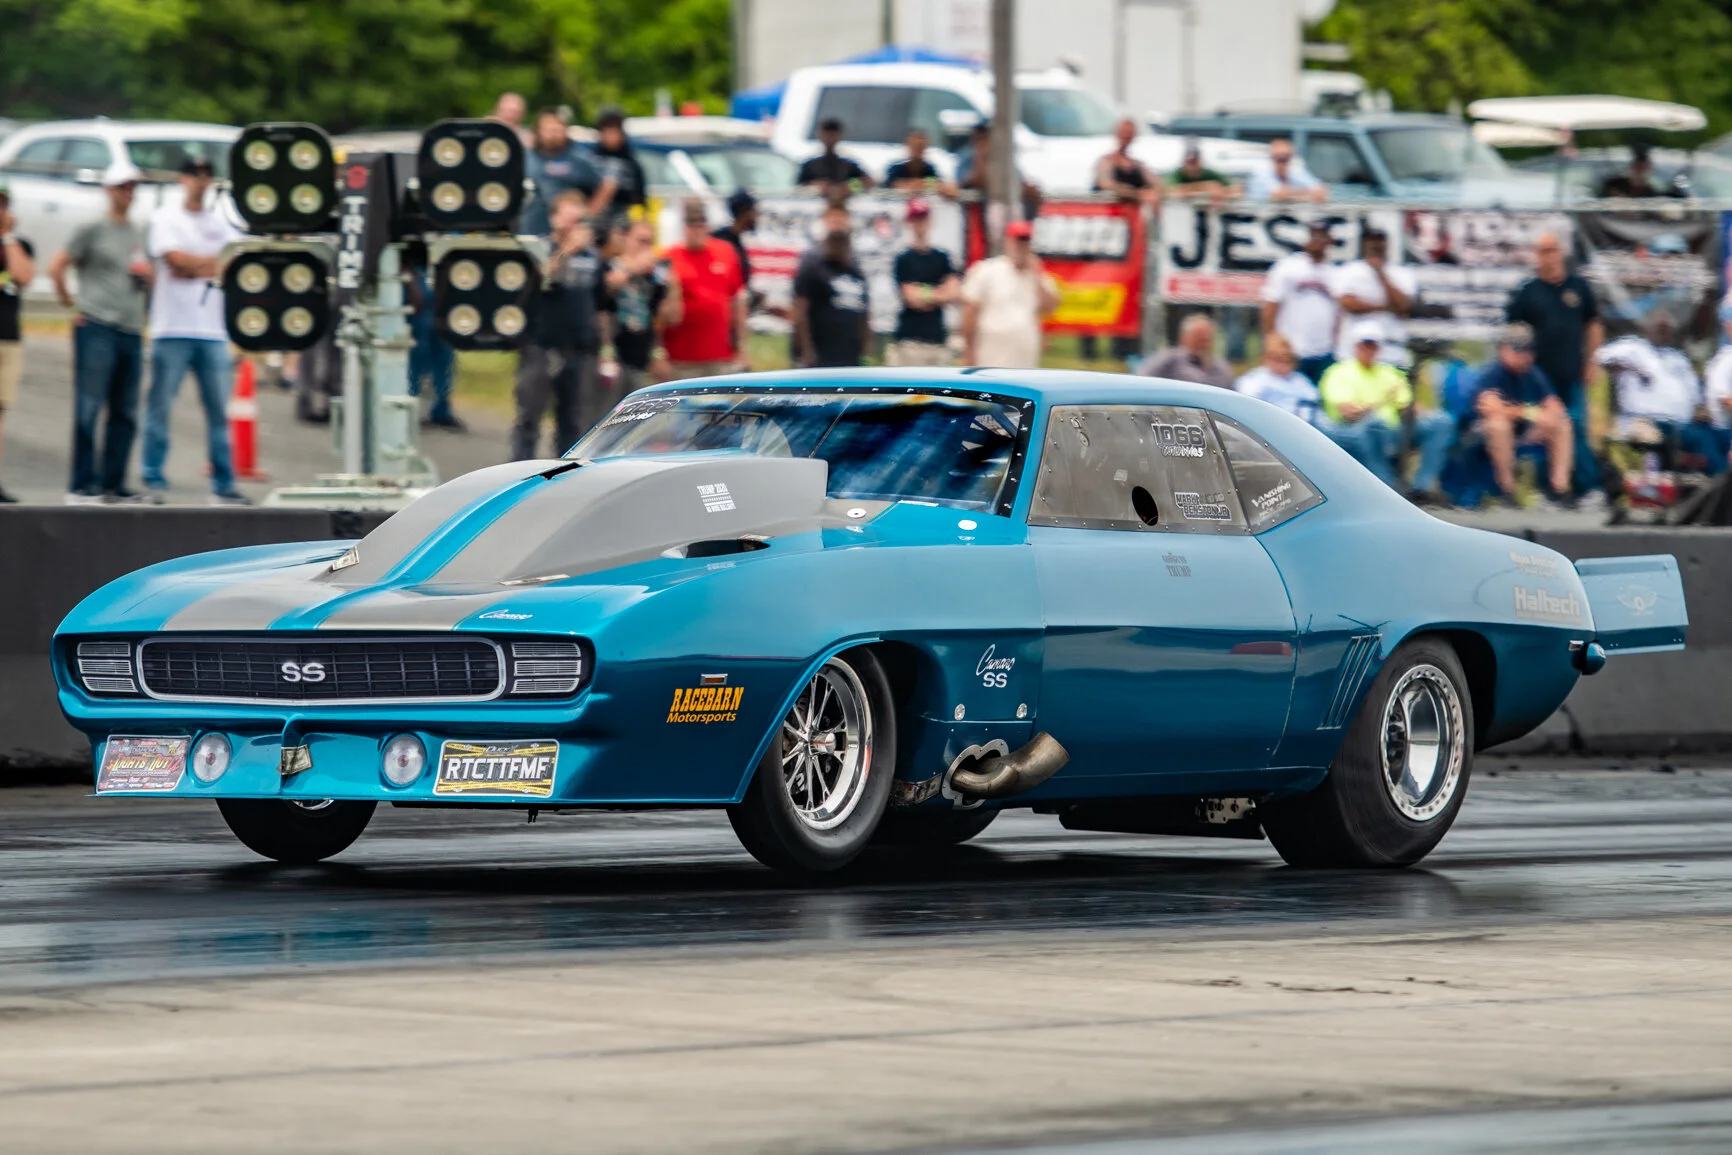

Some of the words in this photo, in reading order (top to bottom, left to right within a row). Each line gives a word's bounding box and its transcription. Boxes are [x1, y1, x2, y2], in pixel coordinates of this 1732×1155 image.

[338, 195, 369, 289] TRIME
[1170, 210, 1368, 271] JESE
[1152, 424, 1207, 449] 1066
[1251, 481, 1291, 507] VANISHING
[1261, 493, 1282, 509] POINT
[1513, 587, 1581, 616] Haltech
[281, 661, 326, 682] SS
[976, 644, 1015, 676] Camaro
[983, 672, 1008, 688] SS
[670, 687, 745, 712] RACEBARN
[666, 712, 737, 724] Motorsports
[445, 757, 550, 780] RTCTTFMF
